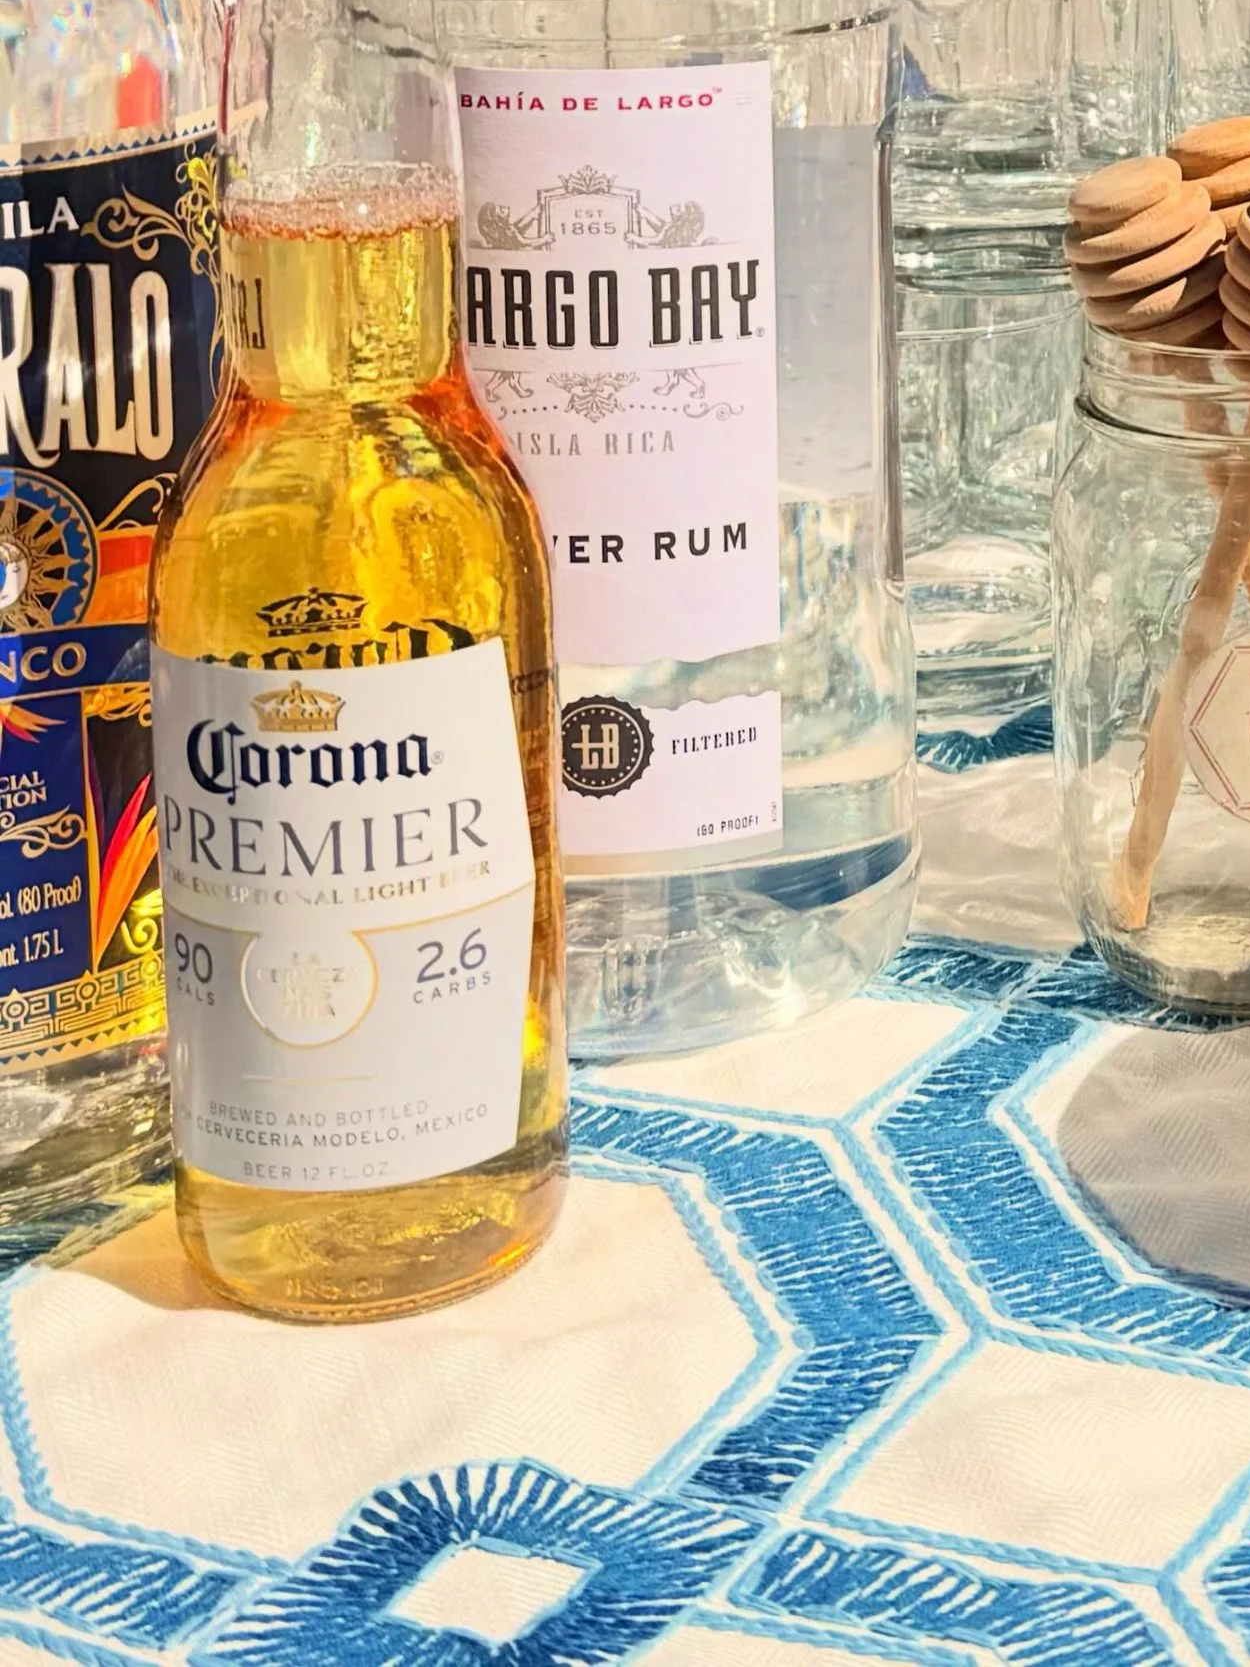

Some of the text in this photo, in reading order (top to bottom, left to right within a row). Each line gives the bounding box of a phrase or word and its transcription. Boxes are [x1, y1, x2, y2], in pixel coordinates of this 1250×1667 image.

[460, 91, 545, 111] BAHÍA
[562, 97, 598, 111] DE
[560, 222, 617, 235] 1865
[574, 209, 604, 219] EST
[466, 266, 620, 350] ARGO
[604, 429, 676, 457] RICA
[553, 522, 747, 564] ER RUM
[671, 726, 758, 755] FILTERED
[163, 797, 489, 878] PREMIER
[17, 885, 41, 916] (80
[43, 874, 82, 910] Proof)
[353, 877, 432, 904] LIGHT
[439, 859, 490, 889] BEER
[23, 930, 51, 963] 1.75
[52, 927, 65, 956] L
[174, 927, 488, 985] 90 2.6
[175, 970, 493, 1007] CALS CARBS
[196, 1102, 490, 1148] CERVECERIA MODELO, MEXICO
[208, 1100, 278, 1127] BREWED
[286, 1109, 327, 1128] AND
[335, 1099, 430, 1127] BOTTLED
[243, 1160, 293, 1183] BEER
[302, 1166, 321, 1182] 12
